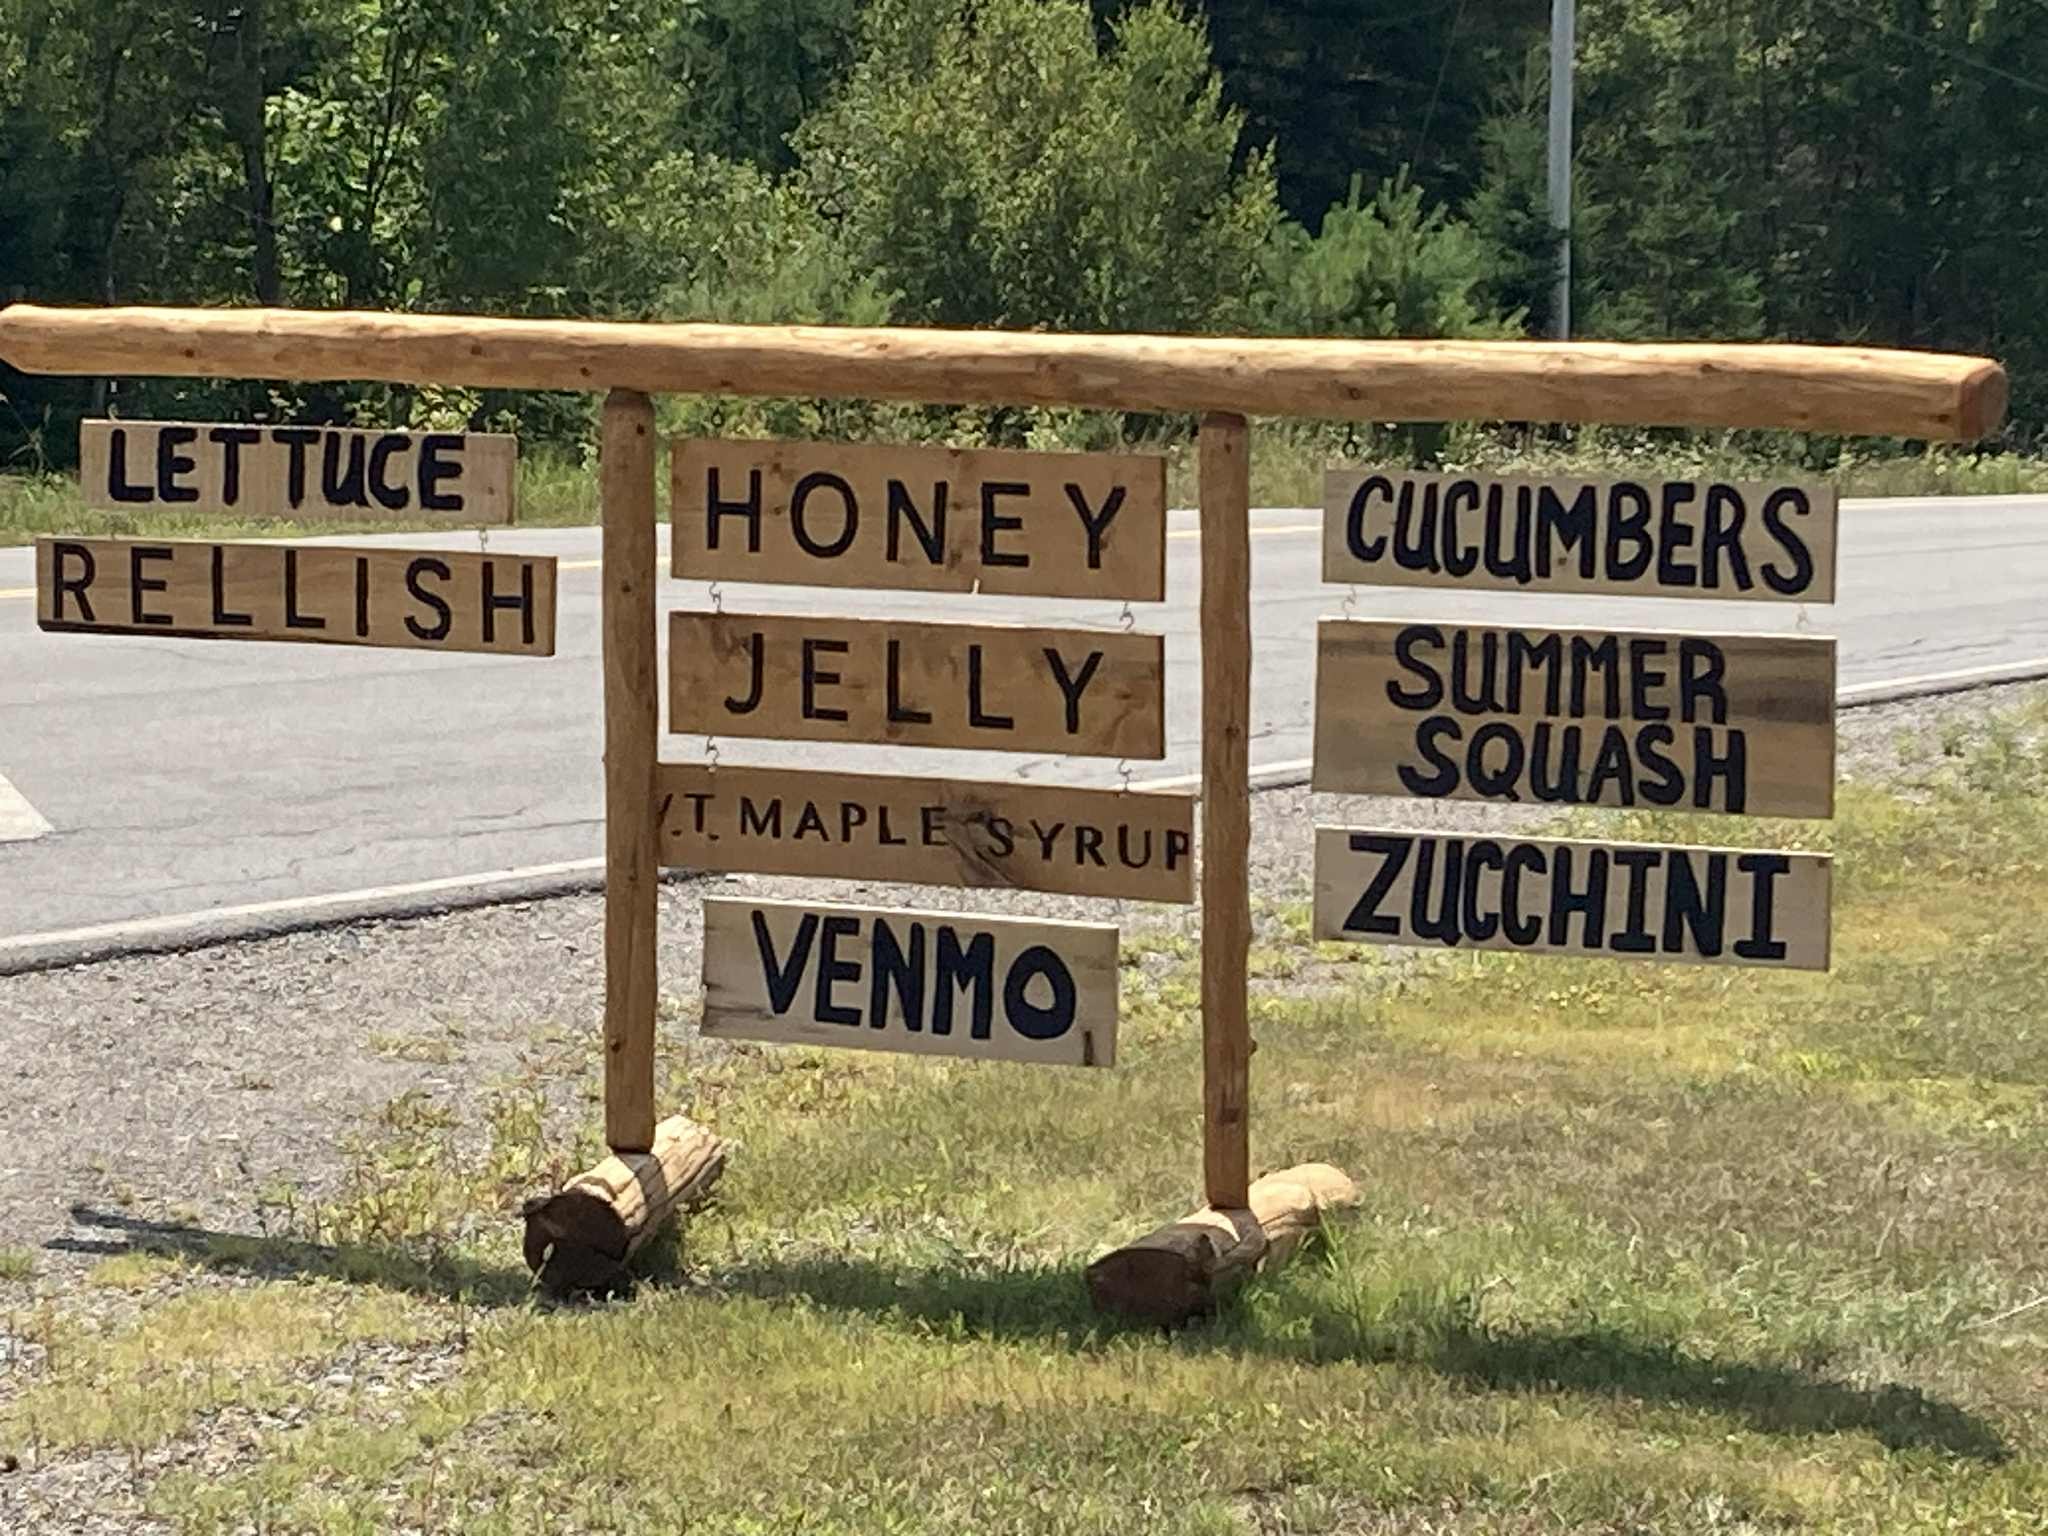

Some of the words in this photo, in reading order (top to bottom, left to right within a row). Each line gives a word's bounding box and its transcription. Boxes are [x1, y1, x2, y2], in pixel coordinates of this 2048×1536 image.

[108, 427, 465, 511] LETTUCE
[706, 466, 1127, 569] HONEY
[1347, 476, 1814, 595] CUCUMBERS
[52, 542, 535, 644] RELLISH
[724, 632, 1104, 734] JELLY
[1386, 625, 1727, 724] SUMMER
[1396, 716, 1746, 813] SQUASH
[740, 796, 949, 846] MAPLE
[986, 817, 1190, 871] SYRUP
[1343, 834, 1790, 959] ZUCCHINI
[751, 910, 1077, 1040] VENMO
